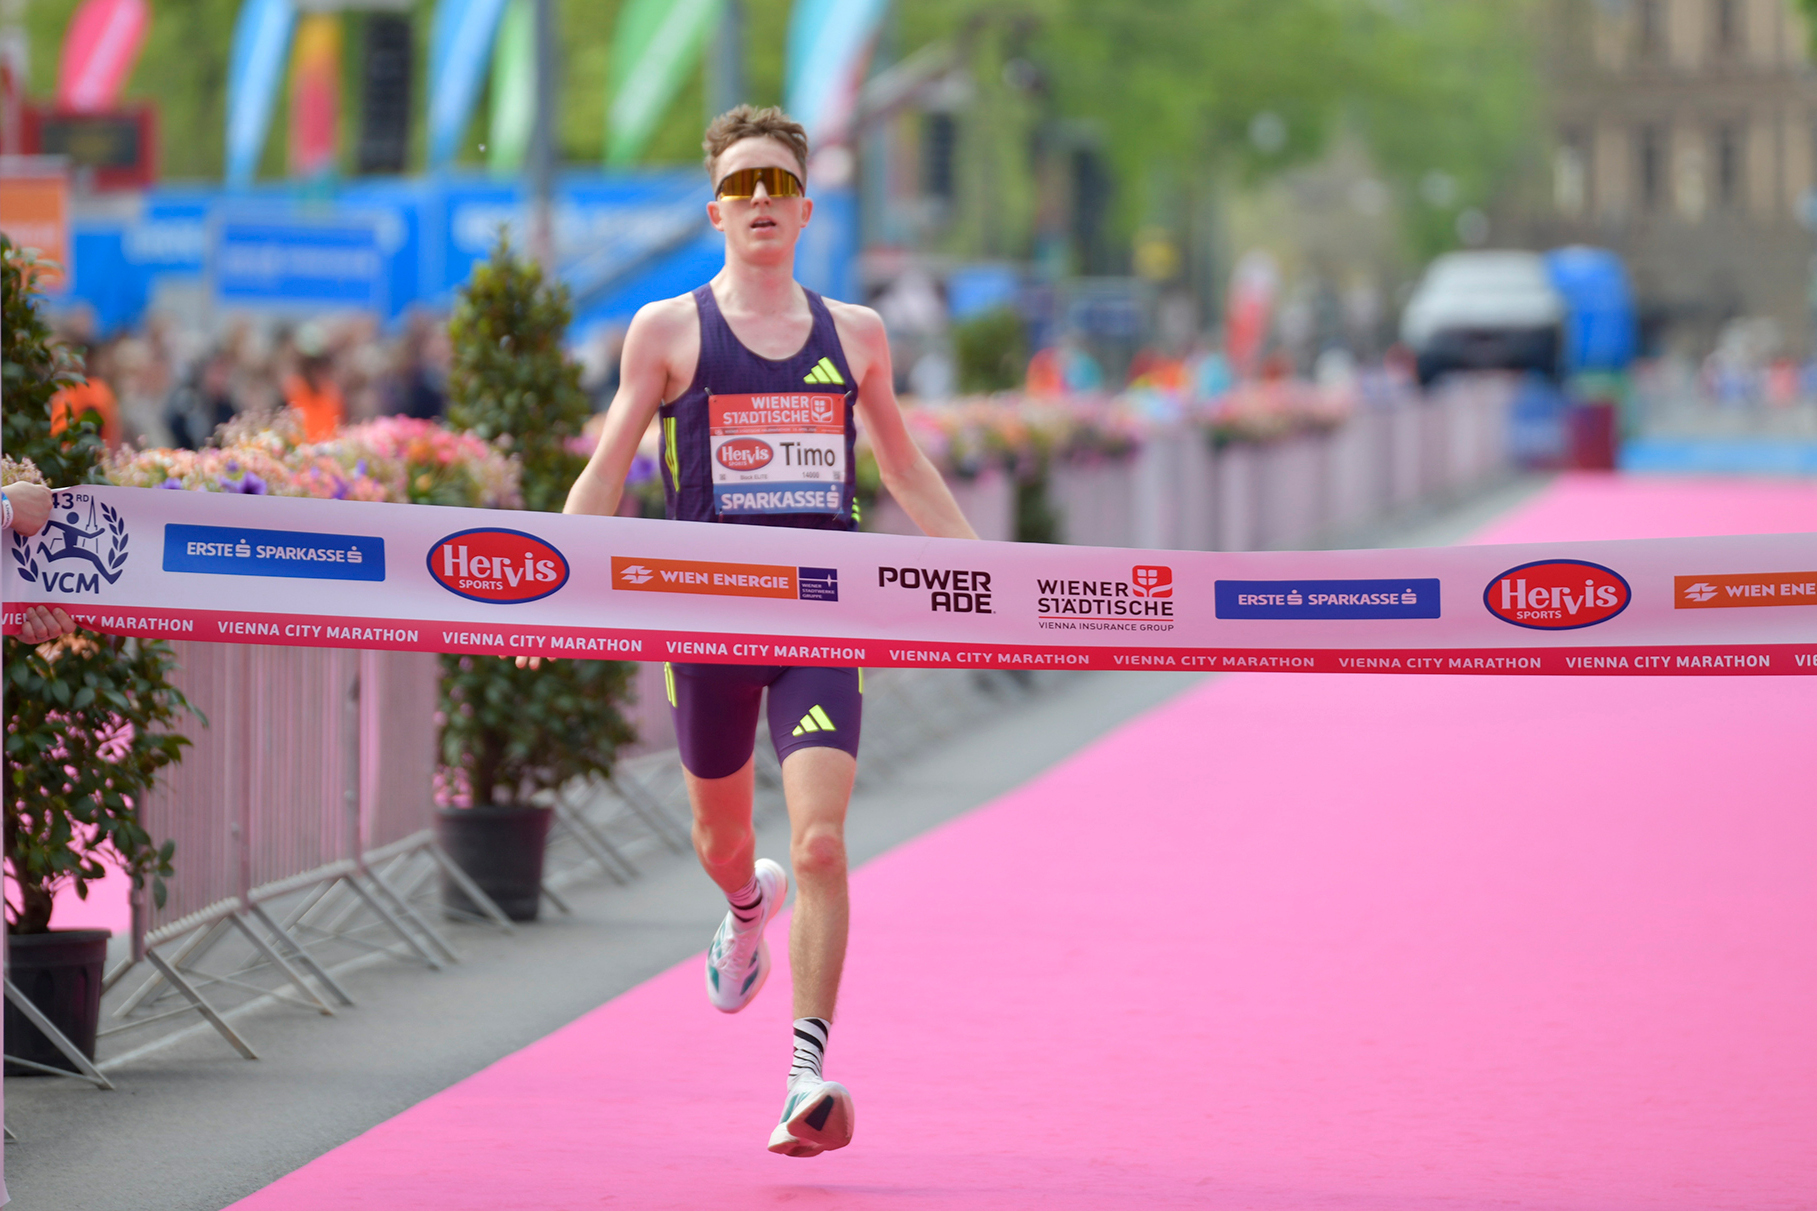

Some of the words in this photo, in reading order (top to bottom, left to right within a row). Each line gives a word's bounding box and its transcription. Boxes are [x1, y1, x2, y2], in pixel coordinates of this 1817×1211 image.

[752, 396, 809, 409] WIENER
[724, 410, 810, 424] STÄDTISCHE
[722, 446, 769, 464] Hervis
[780, 442, 836, 466] Timo
[721, 491, 824, 510] SPARKASSE
[187, 542, 233, 558] ERSTE
[256, 544, 344, 562] SPARKASSE
[443, 544, 557, 588] Hervis
[42, 572, 100, 594] VCM
[458, 579, 504, 590] SPORTS
[660, 570, 708, 585] WIEN
[713, 573, 790, 590] ENERGIE
[878, 566, 991, 592] POWER
[1038, 578, 1128, 597] WIENER
[1501, 578, 1618, 614] Hervis
[1725, 584, 1775, 597] WIEN
[1780, 582, 1816, 596] ENE
[1038, 597, 1174, 616] STÄDTISCHE
[1238, 594, 1284, 606] ERSTE
[1308, 593, 1398, 606] SPARKASSE
[101, 616, 194, 632] MARATHON
[1516, 610, 1562, 620] SPORTS
[218, 620, 280, 636] VIENNA
[285, 624, 322, 638] CITY
[326, 626, 419, 643] MARATHON
[1038, 622, 1076, 630] VIENNA
[1079, 622, 1138, 631] INSURANCE
[1140, 624, 1174, 632] GROUP
[443, 632, 504, 647] VIENNA
[509, 634, 546, 648] CITY
[550, 636, 642, 652] MARATHON
[666, 641, 728, 656] VIENNA
[733, 644, 770, 658] CITY
[774, 645, 866, 660] MARATHON
[889, 650, 952, 662] VIENNA
[956, 652, 993, 663] CITY
[998, 653, 1090, 665] MARATHON
[1114, 654, 1176, 666] VIENNA
[1181, 655, 1218, 666] CITY
[1222, 656, 1314, 667] MARATHON
[1339, 657, 1402, 668] VIENNA
[1406, 658, 1443, 668] CITY
[1448, 657, 1541, 669] MARATHON
[1566, 656, 1629, 669] VIENNA
[1634, 656, 1671, 668] CITY
[1676, 654, 1770, 668] MARATHON
